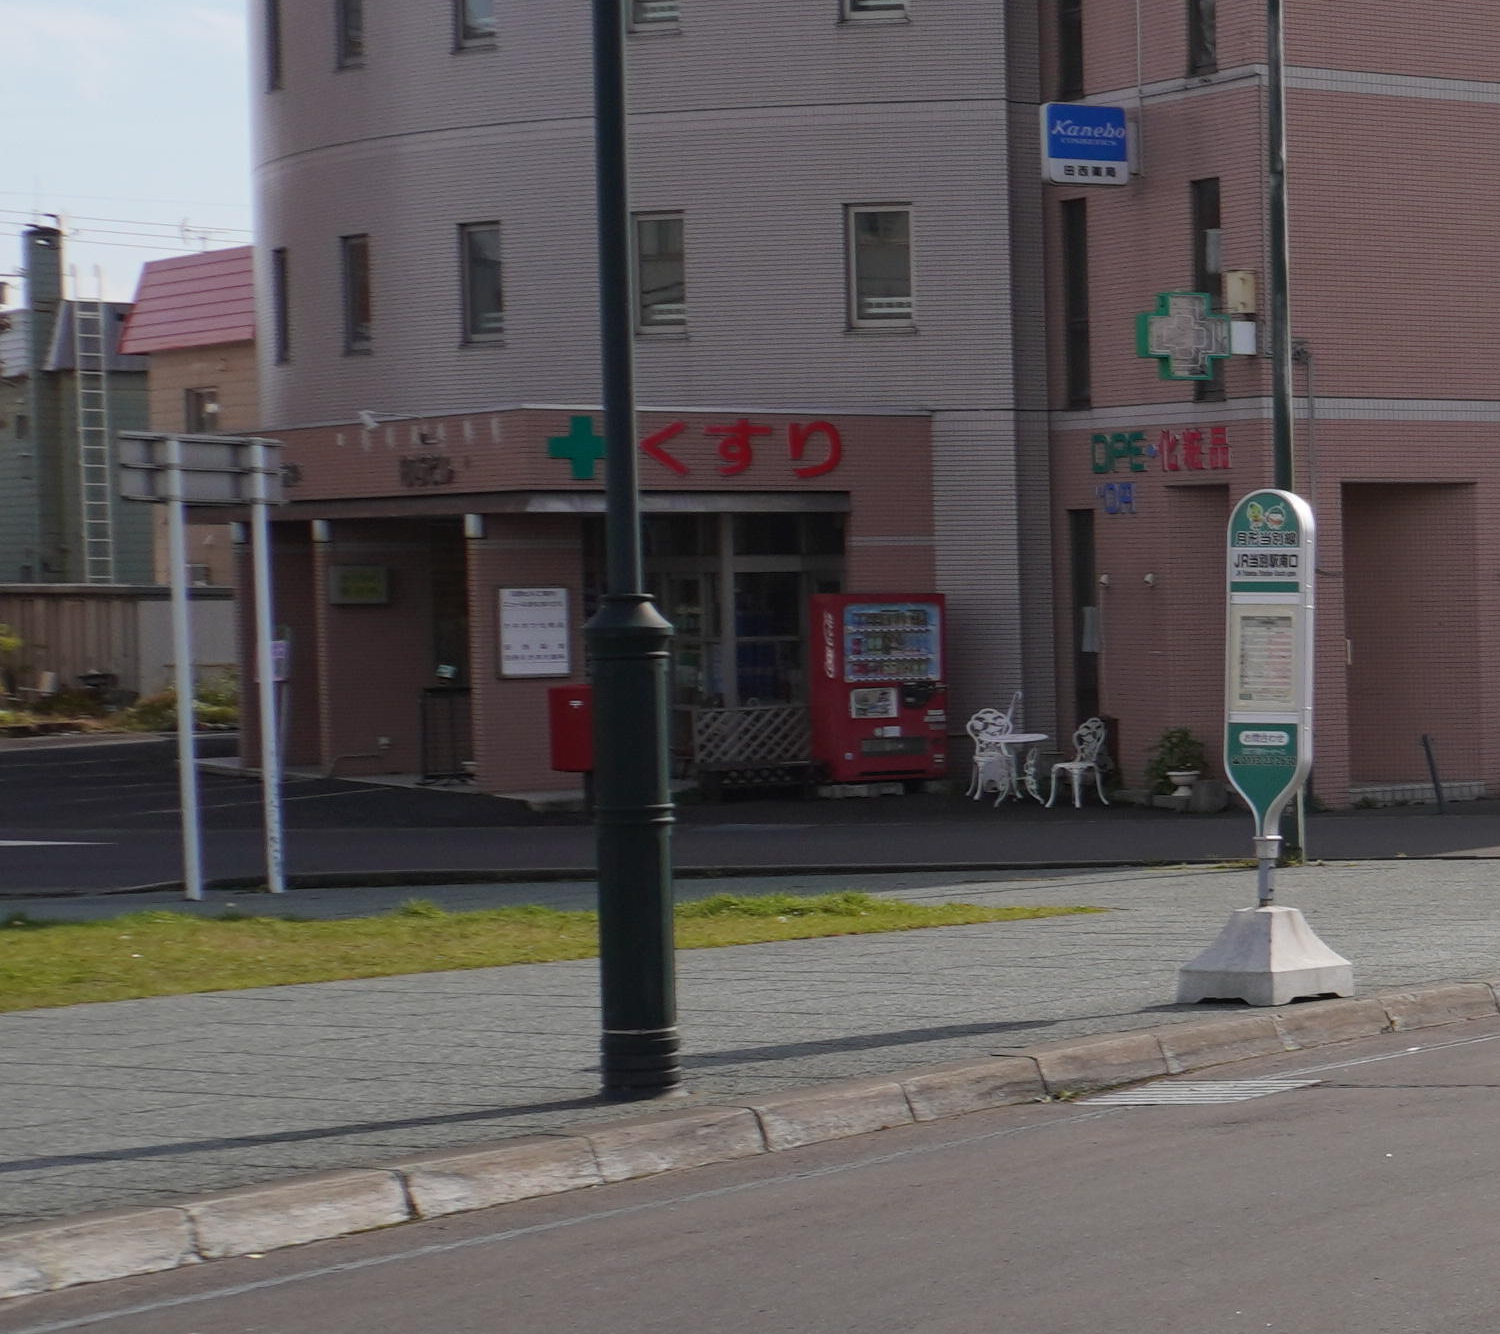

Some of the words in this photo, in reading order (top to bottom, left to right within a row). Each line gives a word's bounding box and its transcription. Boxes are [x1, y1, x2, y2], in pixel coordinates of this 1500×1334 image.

[1052, 119, 1126, 139] Kanebo
[639, 419, 843, 477] くすり
